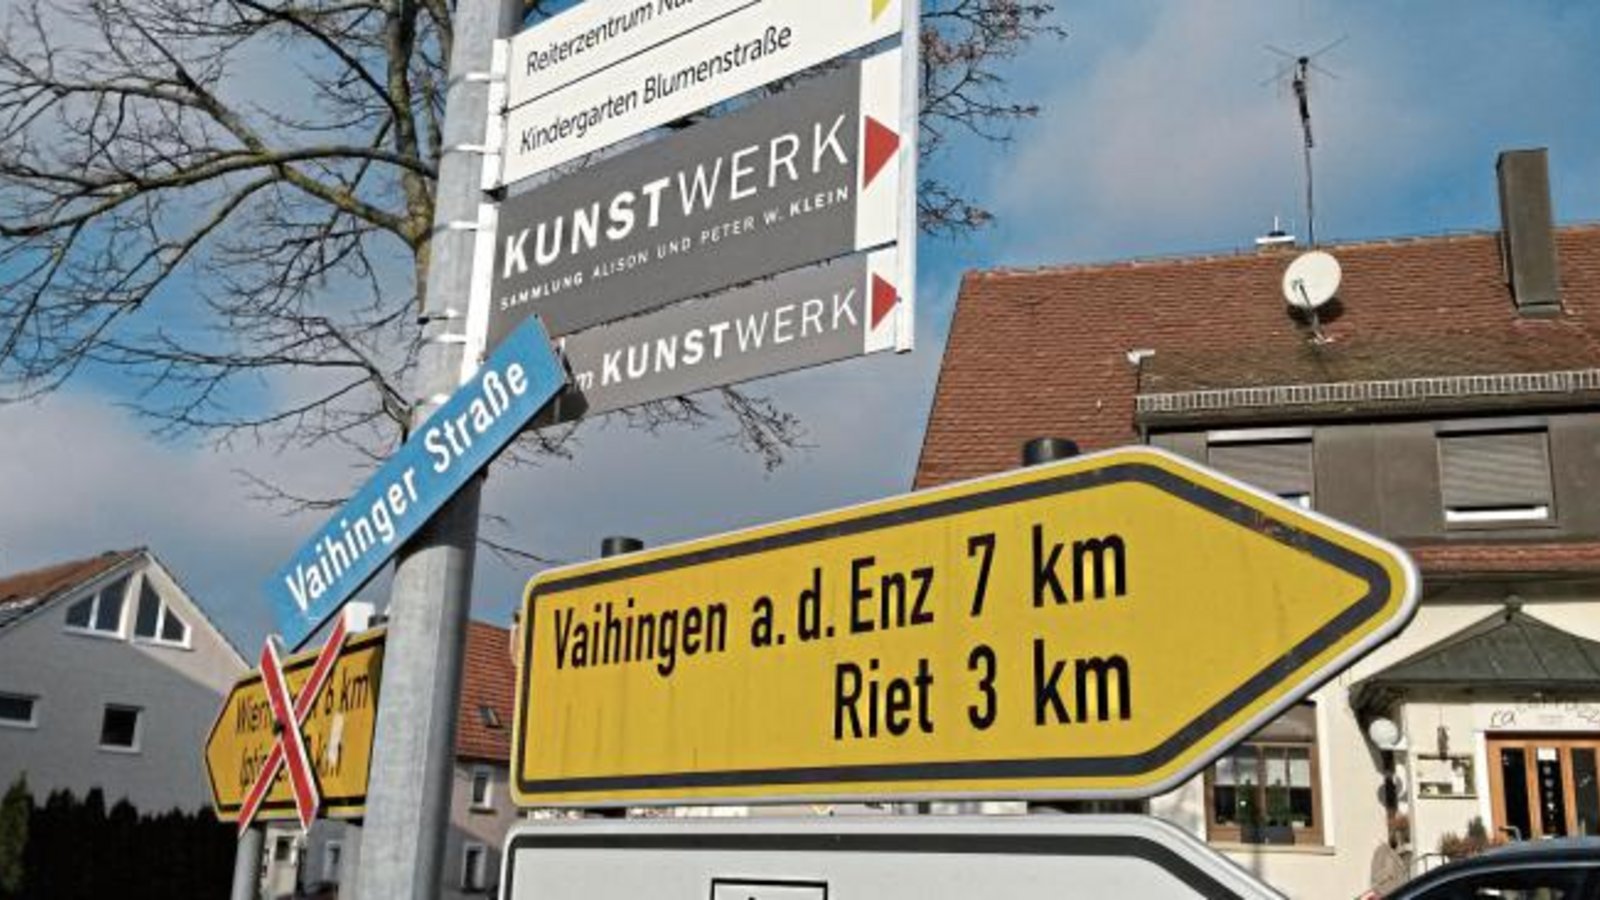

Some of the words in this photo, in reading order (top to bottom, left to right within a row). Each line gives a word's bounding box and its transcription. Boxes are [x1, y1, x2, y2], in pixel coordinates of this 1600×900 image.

[519, 87, 638, 155] Kindergarten
[642, 25, 792, 104] Blumenstraße
[526, 1, 653, 77] Reiterzentrum
[500, 271, 583, 311] SAMMLUNG
[592, 250, 649, 279] ALISON
[656, 237, 692, 260] UND
[701, 216, 755, 244] PETER
[763, 208, 785, 226] W.
[789, 186, 849, 217] KLEIN
[502, 114, 848, 279] KUNSTWERK
[601, 287, 858, 387] KUNSTWERK
[285, 466, 418, 612] Vaihinger
[424, 362, 529, 473] Straße
[553, 598, 728, 677] Vaihingen
[850, 555, 934, 635] Enz
[967, 532, 996, 618] 7
[1031, 523, 1127, 609] km
[342, 665, 368, 712] km
[833, 658, 934, 741] Riet
[967, 643, 997, 731] 3
[1033, 638, 1131, 727] km
